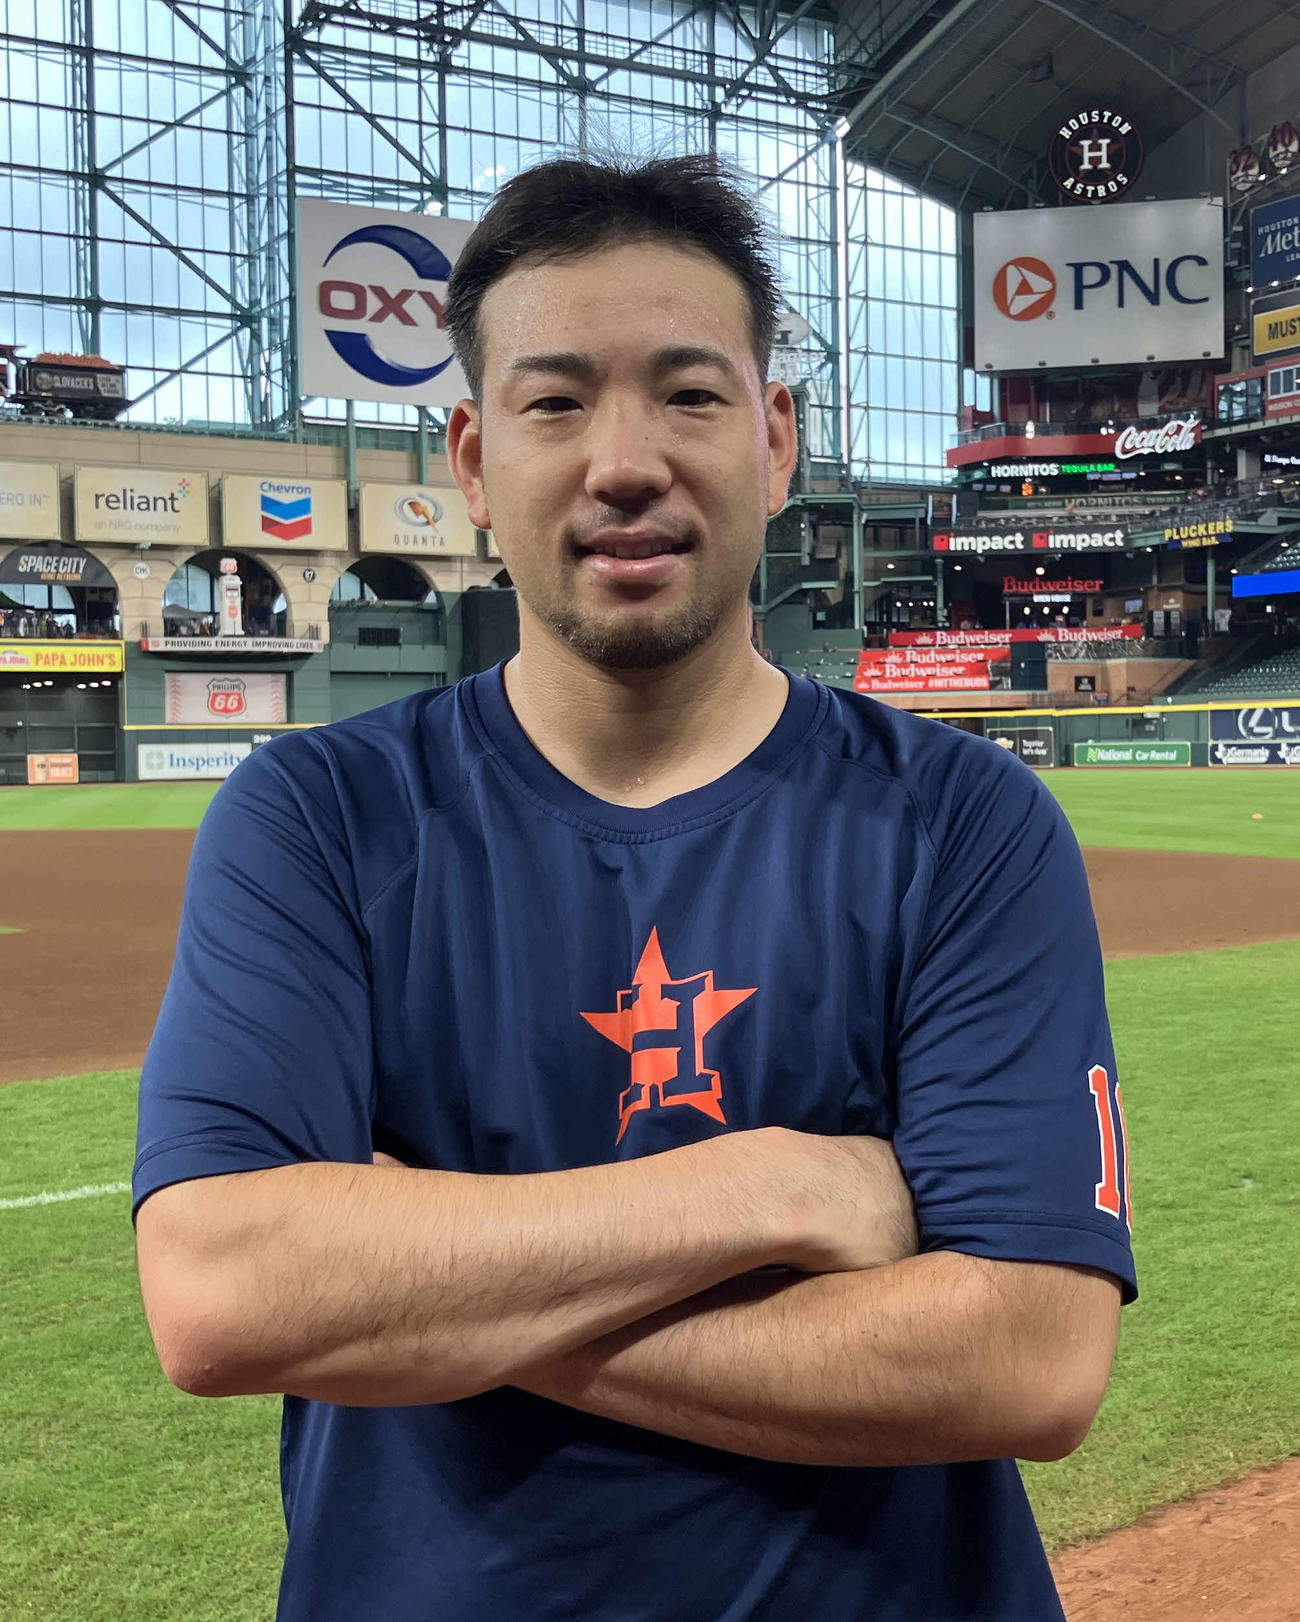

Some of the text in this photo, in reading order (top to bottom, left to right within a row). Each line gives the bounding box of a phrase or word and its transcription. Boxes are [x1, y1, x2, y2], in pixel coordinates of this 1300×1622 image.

[1059, 110, 1132, 139] HOUSTON
[1079, 139, 1111, 170] H
[1062, 173, 1128, 198] ASTROS
[1258, 216, 1299, 235] HOUSTON
[1065, 254, 1210, 311] PNC
[319, 280, 449, 330] OXY
[991, 463, 1059, 478] HORNITOS
[260, 481, 312, 494] Chevron
[94, 488, 181, 513] reliant
[1164, 519, 1234, 541] PLUCKERS
[394, 534, 446, 547] QUANTA
[949, 530, 1124, 553] impact impact
[18, 555, 87, 575] SPACE CITY
[1003, 577, 1104, 593] Budweiser
[164, 640, 212, 648] PROVIDING
[252, 641, 294, 649] IMPROVING
[936, 627, 1124, 645] Budweiser Budweiser
[35, 652, 116, 667] PAPA JOHN'S
[905, 649, 985, 664] Budweiser
[885, 663, 966, 678] Budweiser
[212, 683, 241, 692] PHILLIPS
[871, 679, 925, 690] Budweiser
[214, 694, 239, 710] 66
[1098, 749, 1177, 761] National Car Rental
[1088, 1064, 1132, 1235] 1
